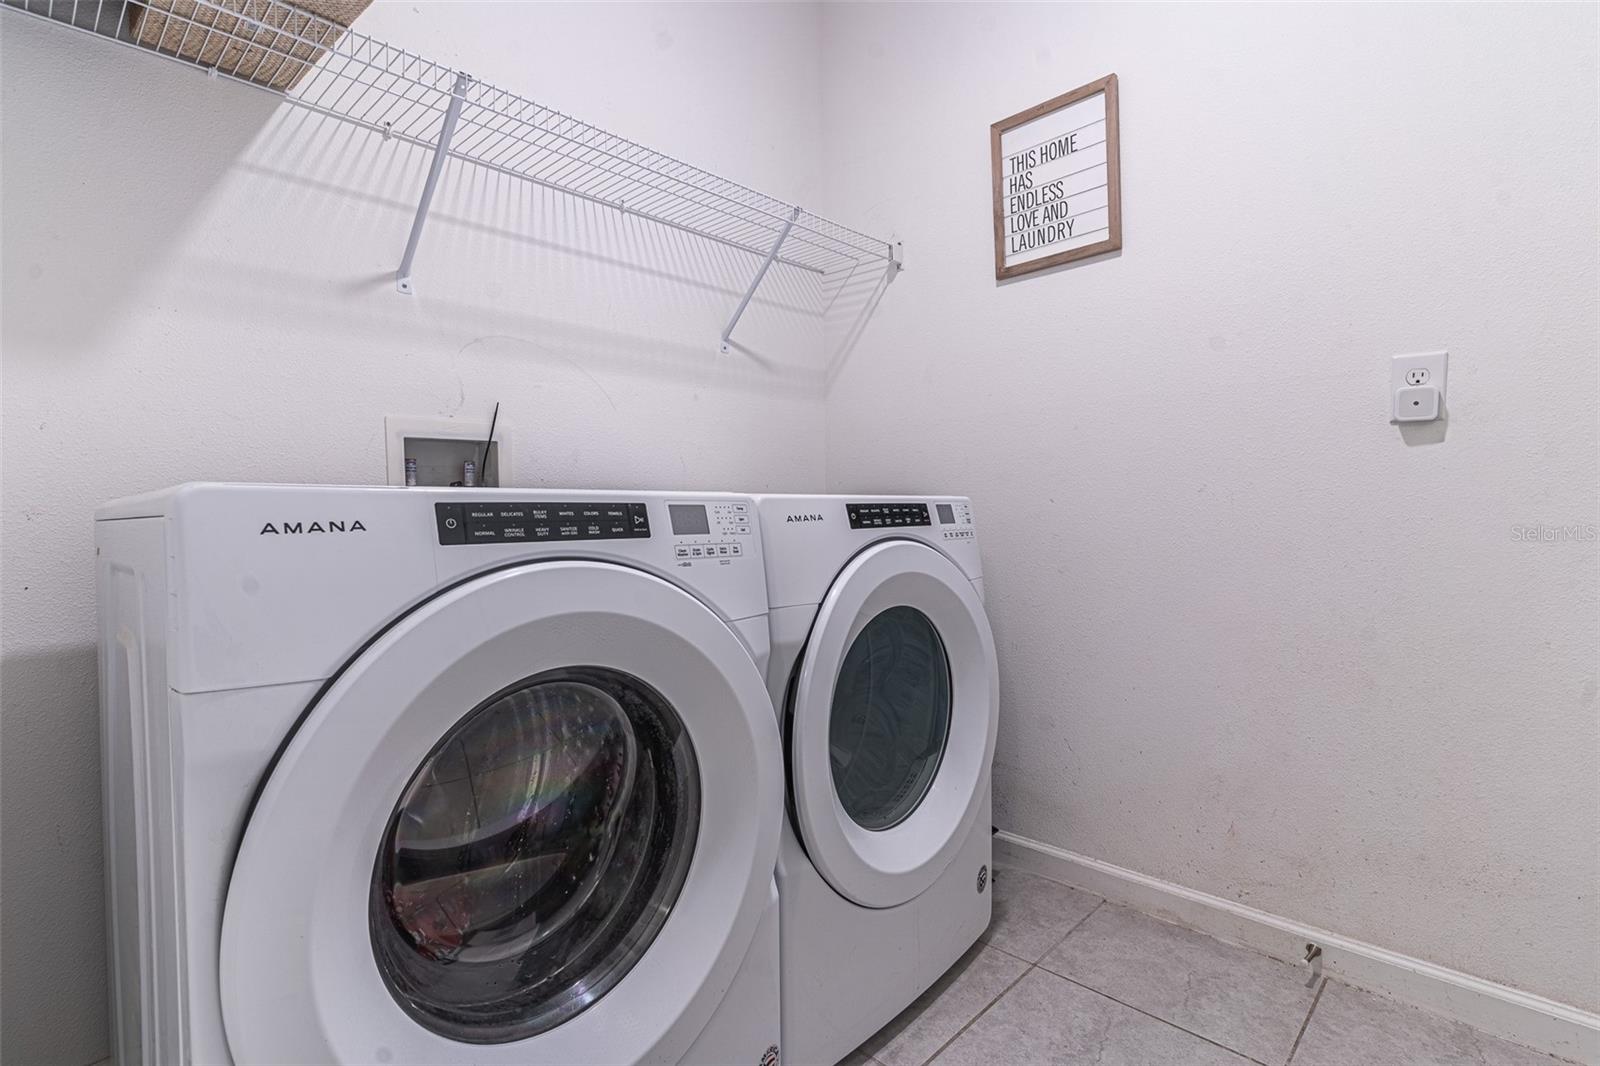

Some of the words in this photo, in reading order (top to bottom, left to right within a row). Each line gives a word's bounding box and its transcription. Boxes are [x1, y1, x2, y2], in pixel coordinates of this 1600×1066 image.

[1009, 149, 1036, 174] THIS
[1040, 133, 1078, 164] HOME
[1009, 170, 1033, 194] HAS
[1010, 180, 1064, 214] ENDLESS
[1011, 208, 1040, 233] LOVE
[1042, 200, 1069, 224] AND
[1011, 218, 1075, 253] LAUNDRY
[260, 520, 367, 536] AMANA
[786, 513, 824, 523] AMANA
